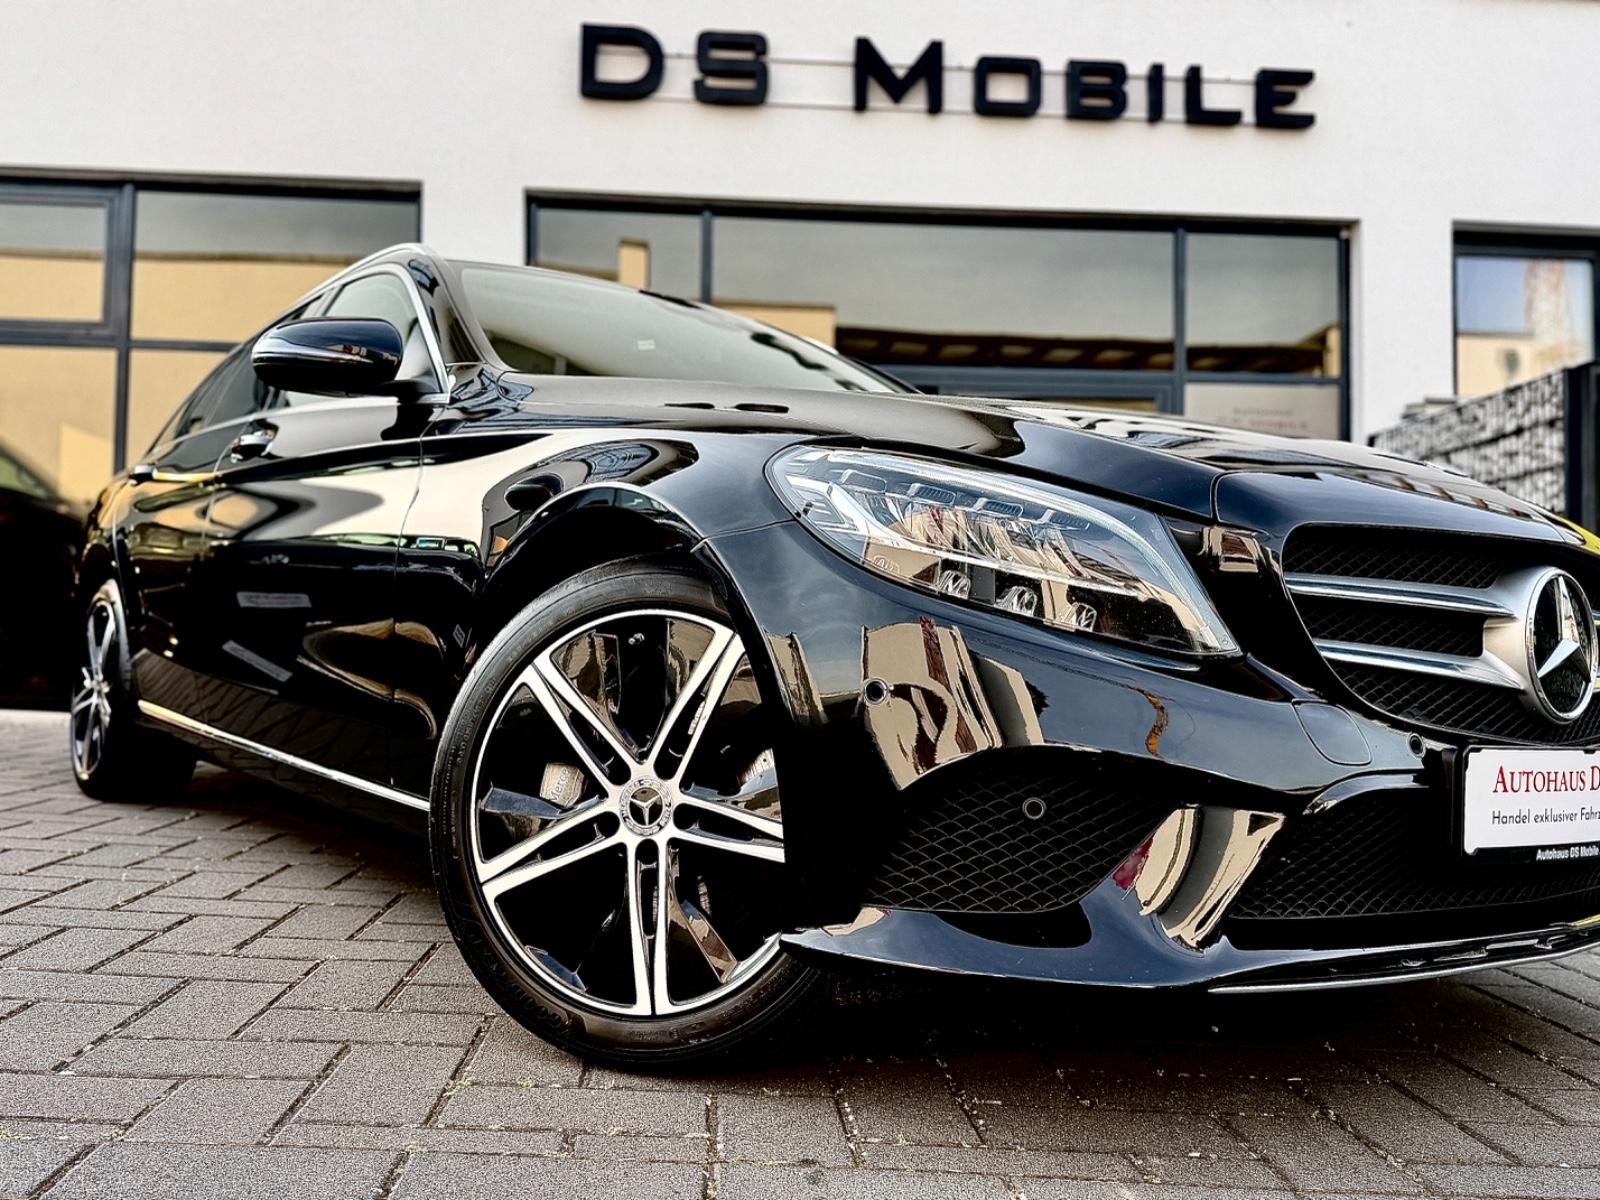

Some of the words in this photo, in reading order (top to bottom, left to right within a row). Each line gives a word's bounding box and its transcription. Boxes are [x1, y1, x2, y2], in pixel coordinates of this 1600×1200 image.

[579, 23, 770, 108] DS
[852, 37, 1316, 132] MOBILE
[1493, 766, 1586, 793] AUTOHAUS
[1492, 809, 1531, 825] Handel
[1533, 808, 1578, 823] exklusiver
[1536, 848, 1569, 861] Autohaus
[1570, 846, 1580, 858] DS
